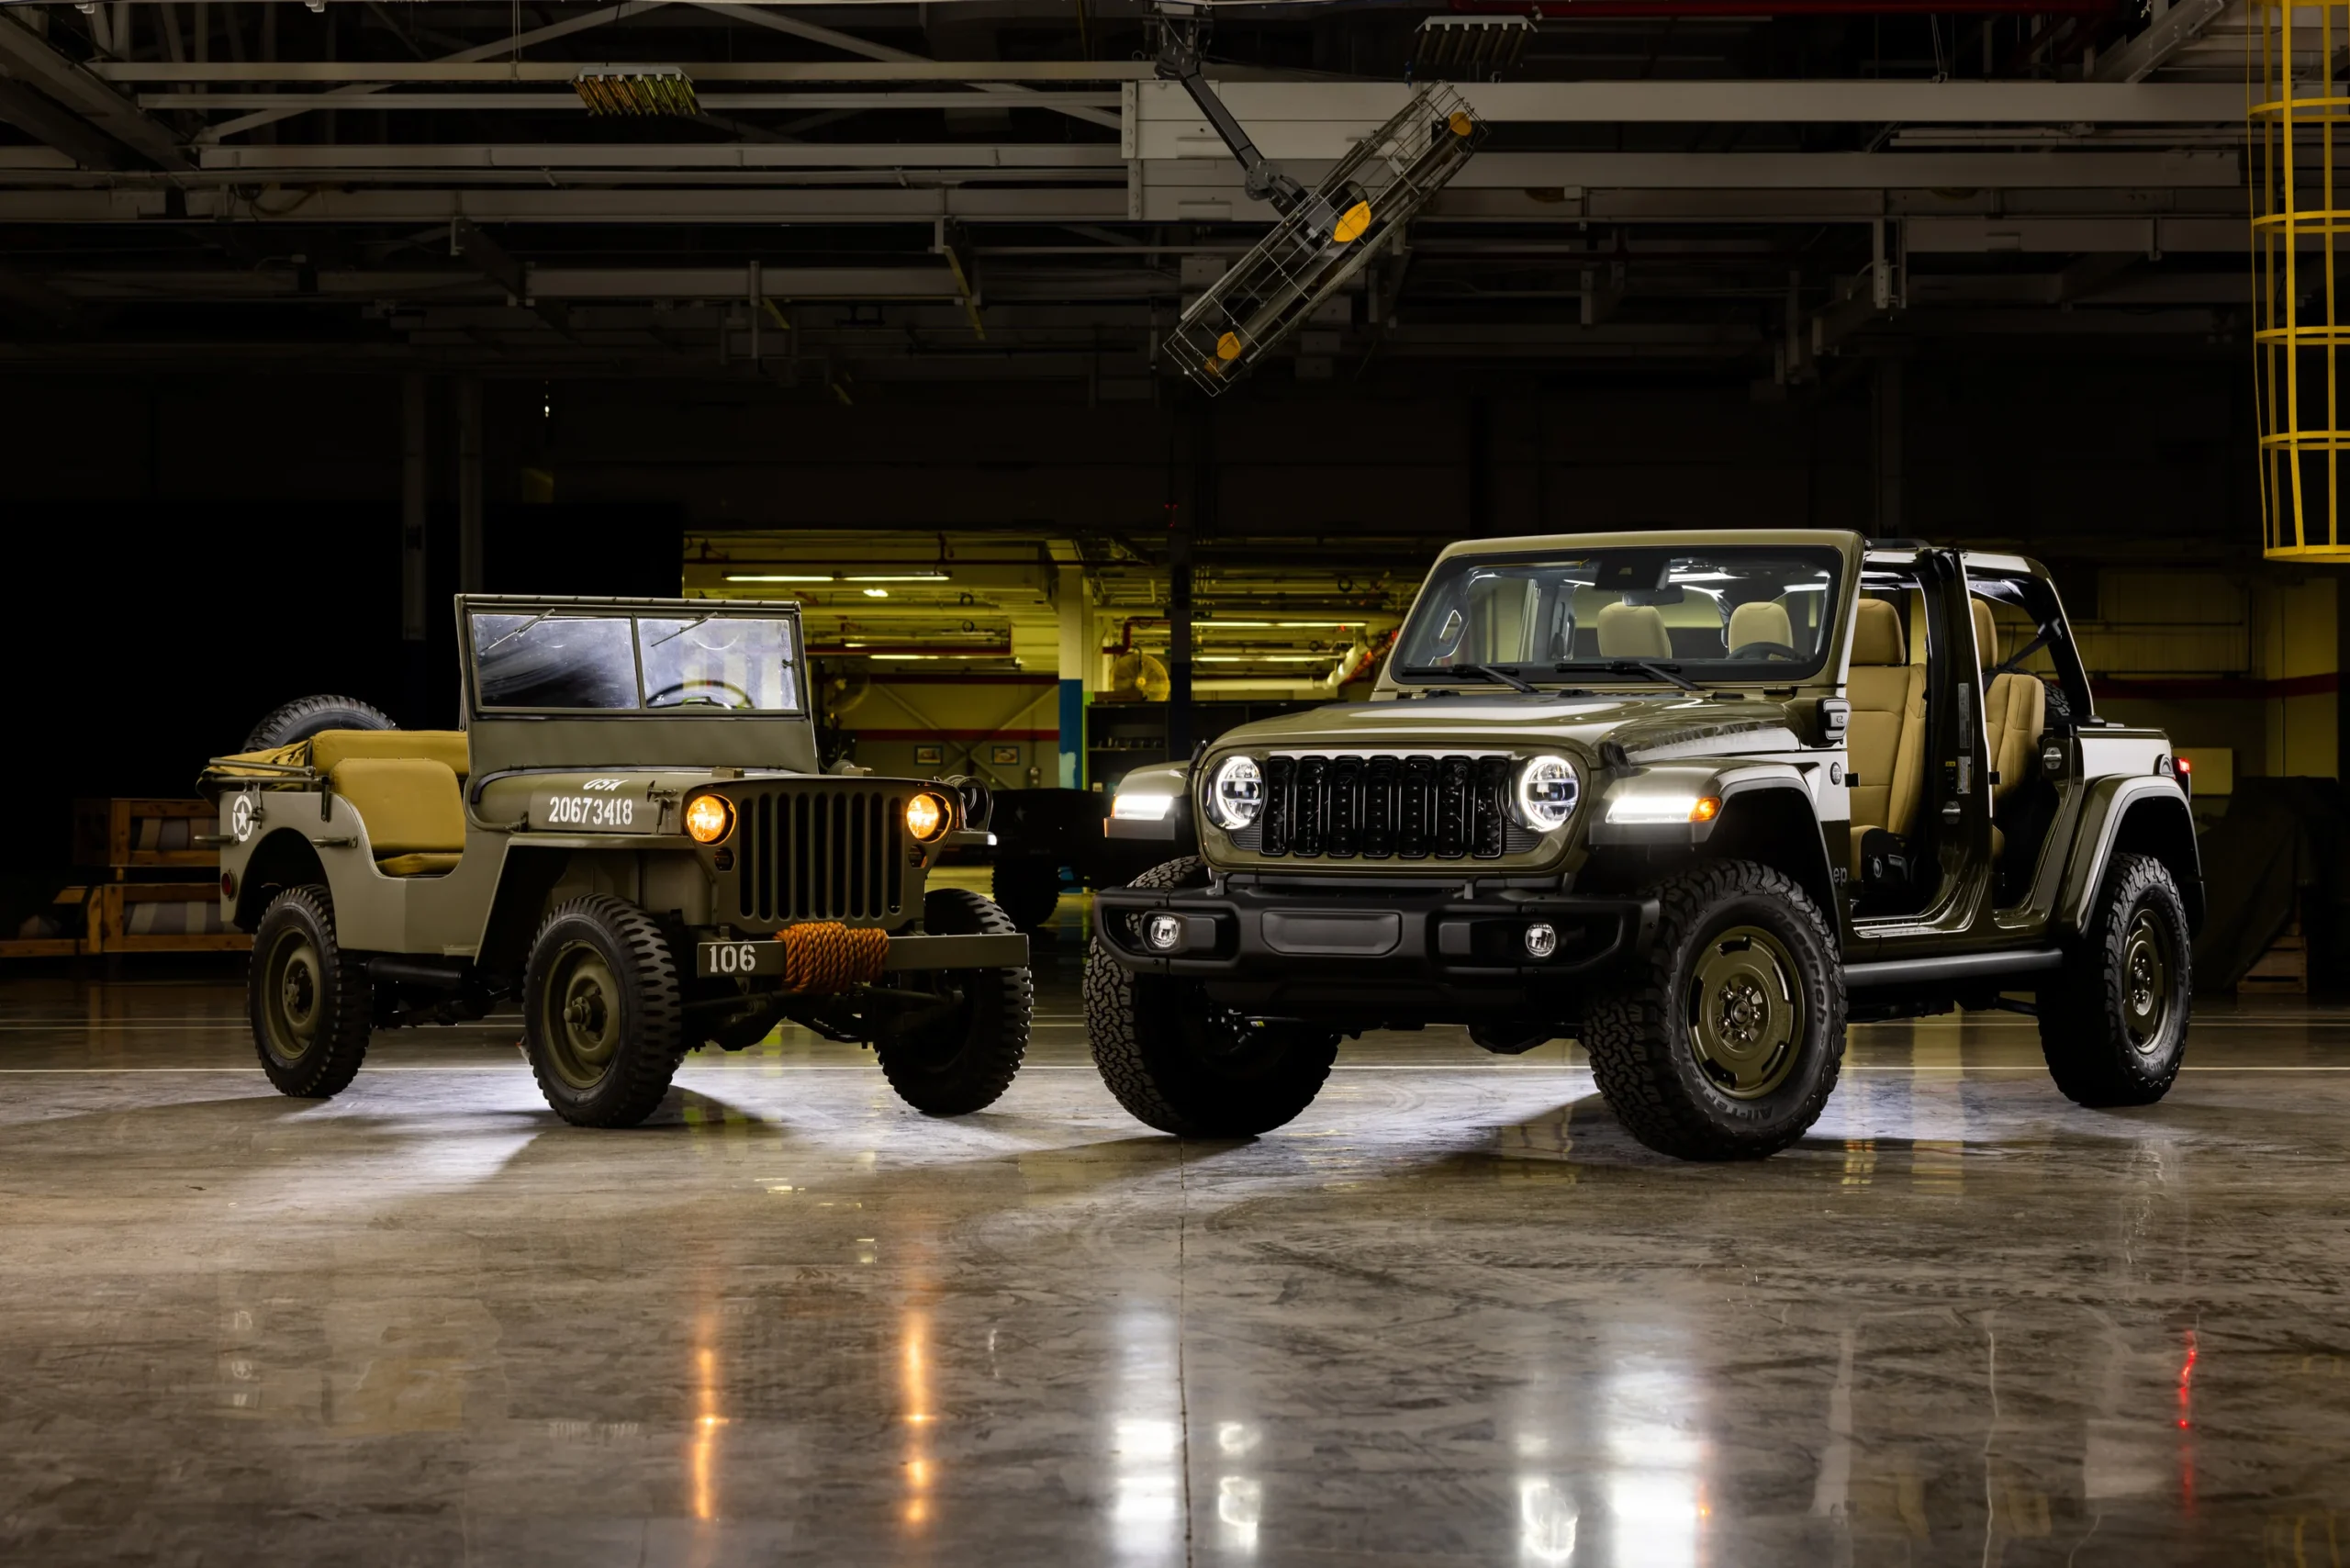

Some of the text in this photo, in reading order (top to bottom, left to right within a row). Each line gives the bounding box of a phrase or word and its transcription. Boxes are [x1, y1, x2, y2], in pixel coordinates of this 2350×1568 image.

[583, 778, 629, 790] USA
[548, 796, 632, 825] 20673418
[1832, 867, 1848, 888] ep
[710, 944, 755, 973] 106
